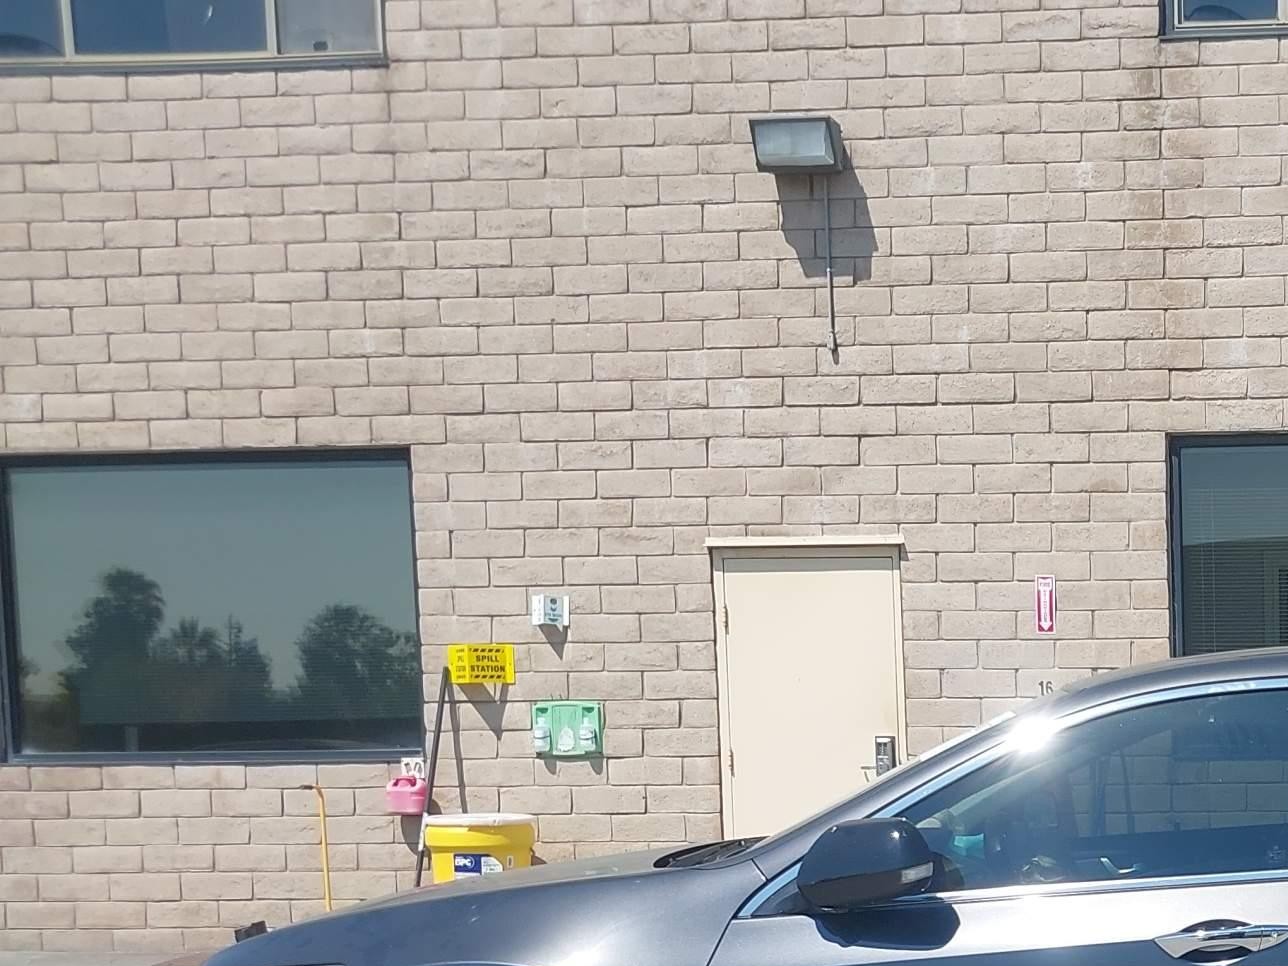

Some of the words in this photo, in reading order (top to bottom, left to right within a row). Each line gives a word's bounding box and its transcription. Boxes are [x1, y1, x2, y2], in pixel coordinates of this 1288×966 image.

[475, 655, 499, 663] SPILL
[470, 665, 505, 673] STATION
[1038, 680, 1053, 696] 16
